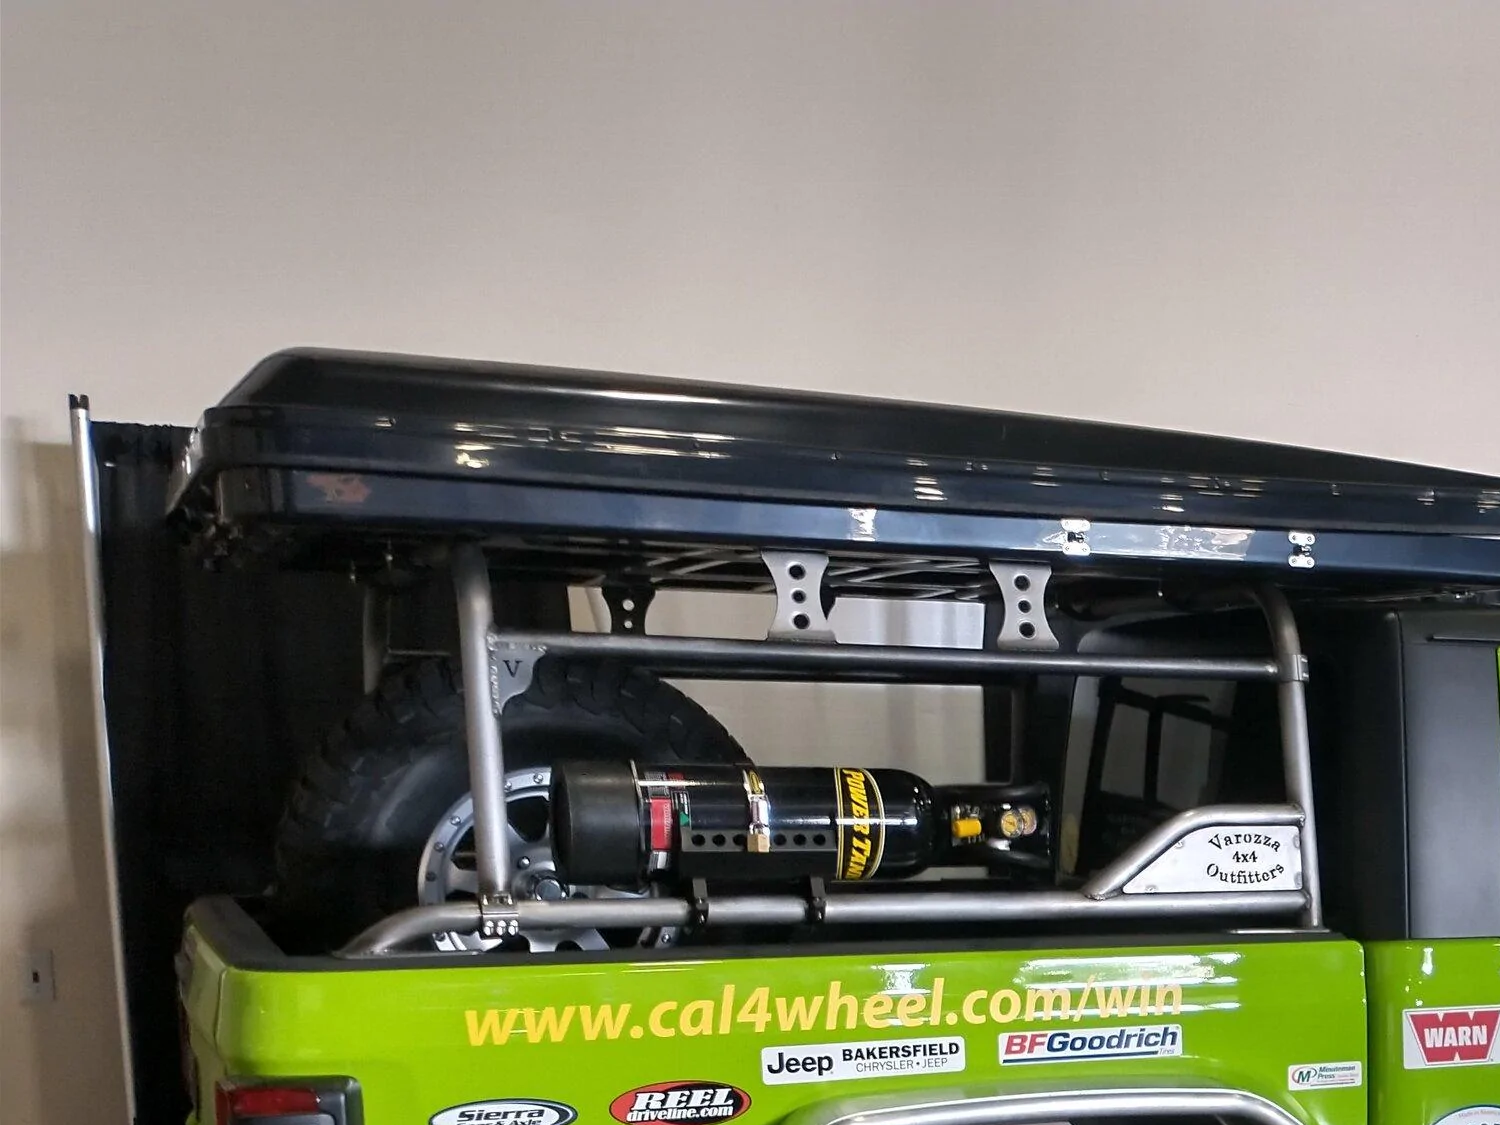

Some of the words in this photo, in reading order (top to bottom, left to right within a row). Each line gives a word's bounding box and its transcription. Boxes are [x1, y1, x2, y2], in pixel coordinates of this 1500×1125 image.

[842, 769, 870, 835] POWER
[1209, 832, 1282, 852] Varozza
[1232, 851, 1258, 863] 4x4
[1206, 863, 1285, 885] Outfitters
[465, 973, 1183, 1047] www.cal4wheel.com/win
[1005, 1026, 1178, 1057] BFGoodrich
[1424, 1025, 1488, 1049] WARN
[842, 1042, 960, 1063] BAKERSFIELD
[767, 1052, 834, 1077] Jeep
[856, 1060, 915, 1073] CHRYSLER
[921, 1057, 948, 1070] JEEP
[630, 1088, 734, 1112] REEL
[456, 1109, 545, 1123] Sierra
[626, 1106, 733, 1123] driveline.com
